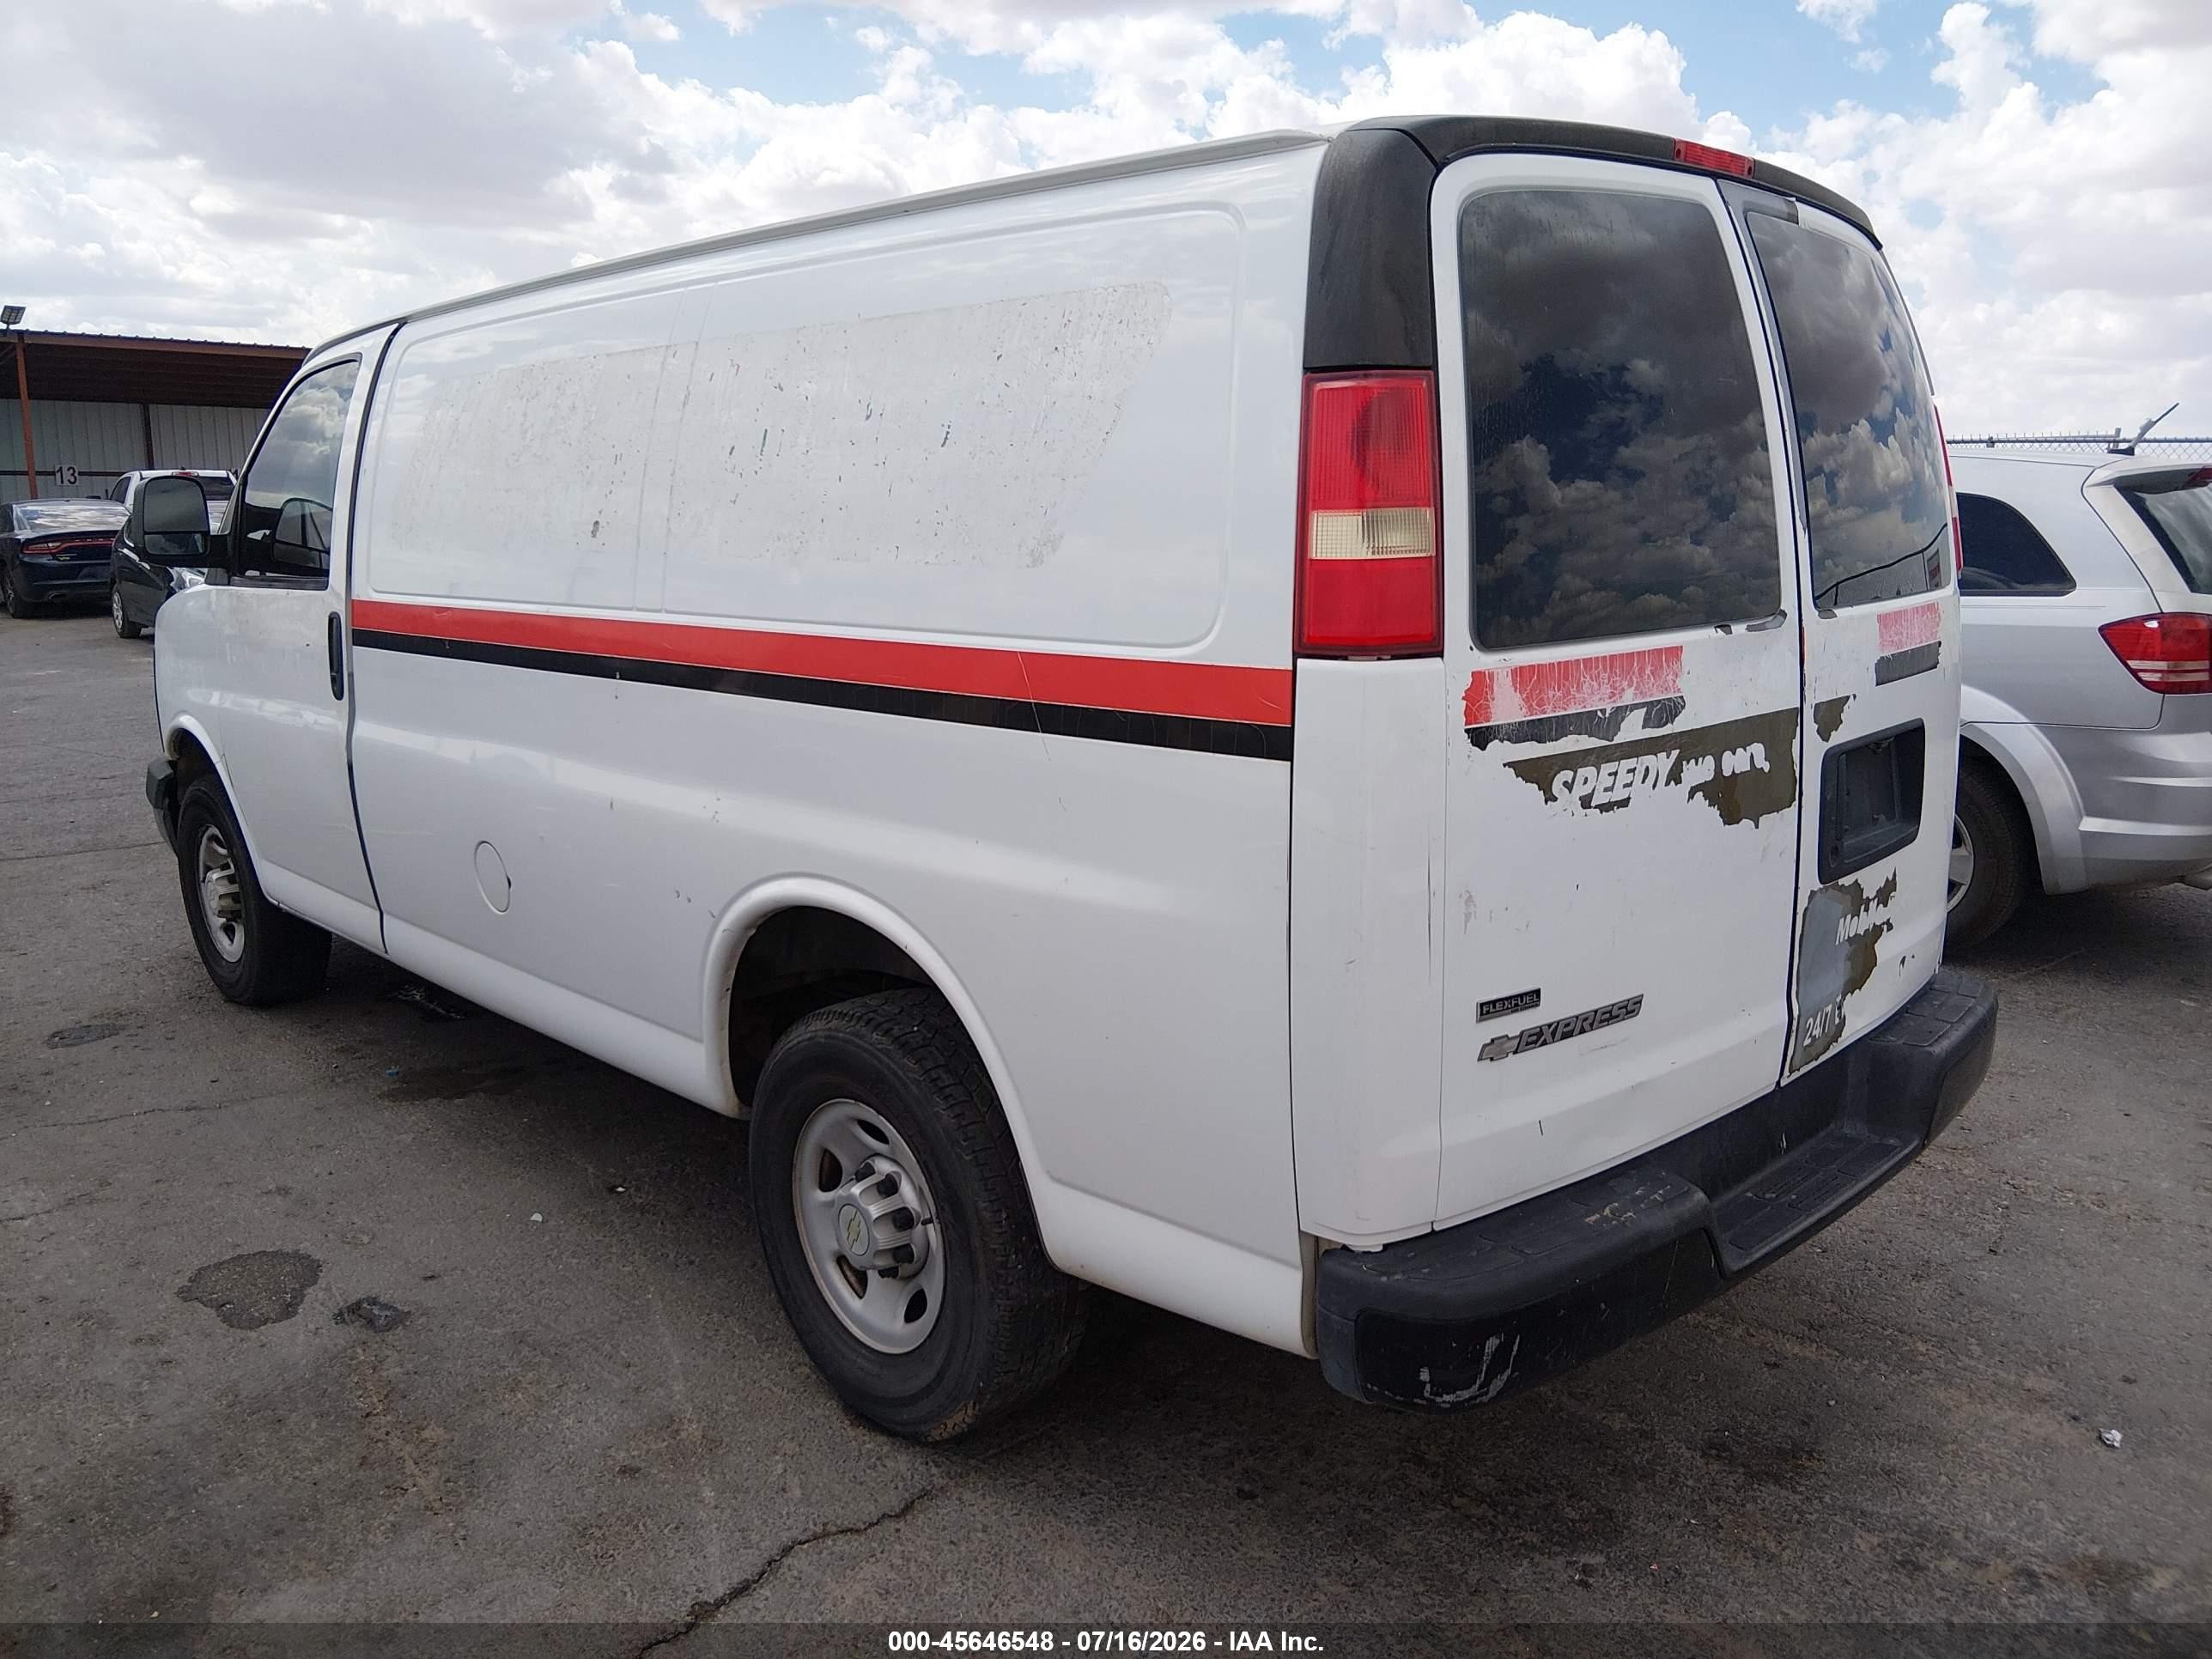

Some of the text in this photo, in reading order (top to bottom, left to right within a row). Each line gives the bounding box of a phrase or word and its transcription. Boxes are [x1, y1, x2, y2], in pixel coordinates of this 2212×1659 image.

[57, 466, 77, 485] 13
[1552, 749, 1680, 809] SPEEDY
[1516, 994, 1644, 1053] EXPRESS
[1802, 1003, 1832, 1047] 24/7
